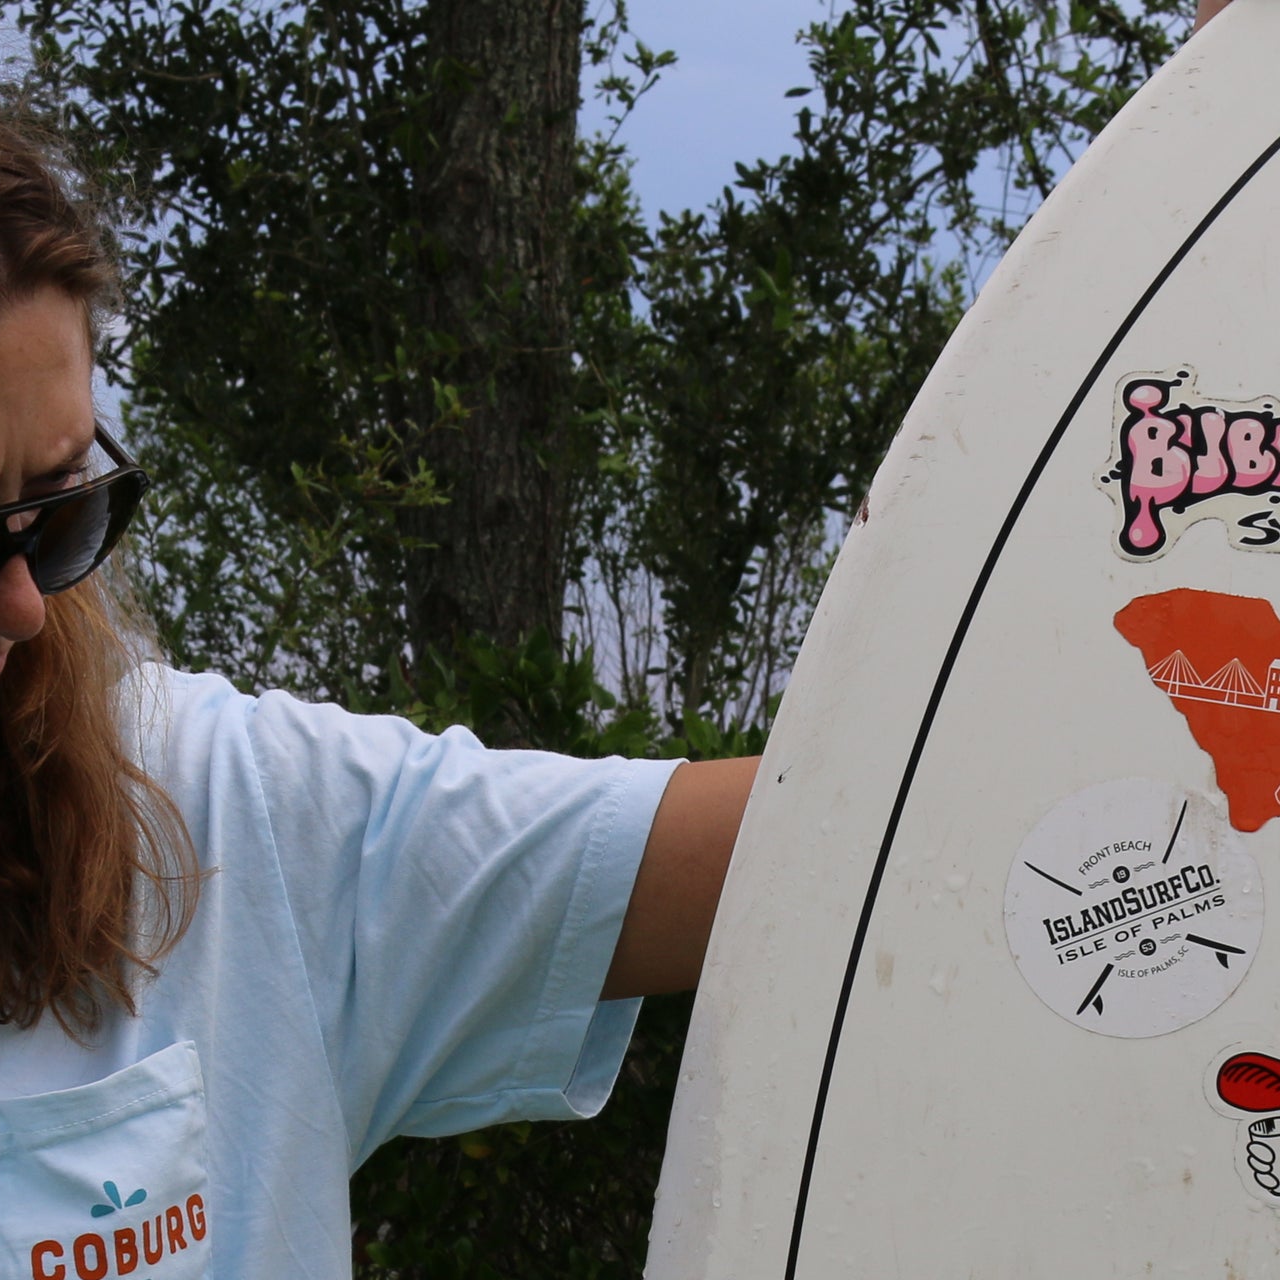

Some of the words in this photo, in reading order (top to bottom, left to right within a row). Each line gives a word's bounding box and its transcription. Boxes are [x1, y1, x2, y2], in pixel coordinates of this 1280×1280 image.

[1078, 846, 1111, 876] FRONT
[1113, 840, 1152, 854] BEACH
[1057, 938, 1107, 965] ISLE
[1114, 924, 1143, 943] OF
[1152, 895, 1226, 931] PALMS
[1117, 968, 1136, 978] ISLE
[1137, 968, 1150, 978] OF
[1151, 955, 1181, 975] PALMS,
[1177, 945, 1190, 958] SC
